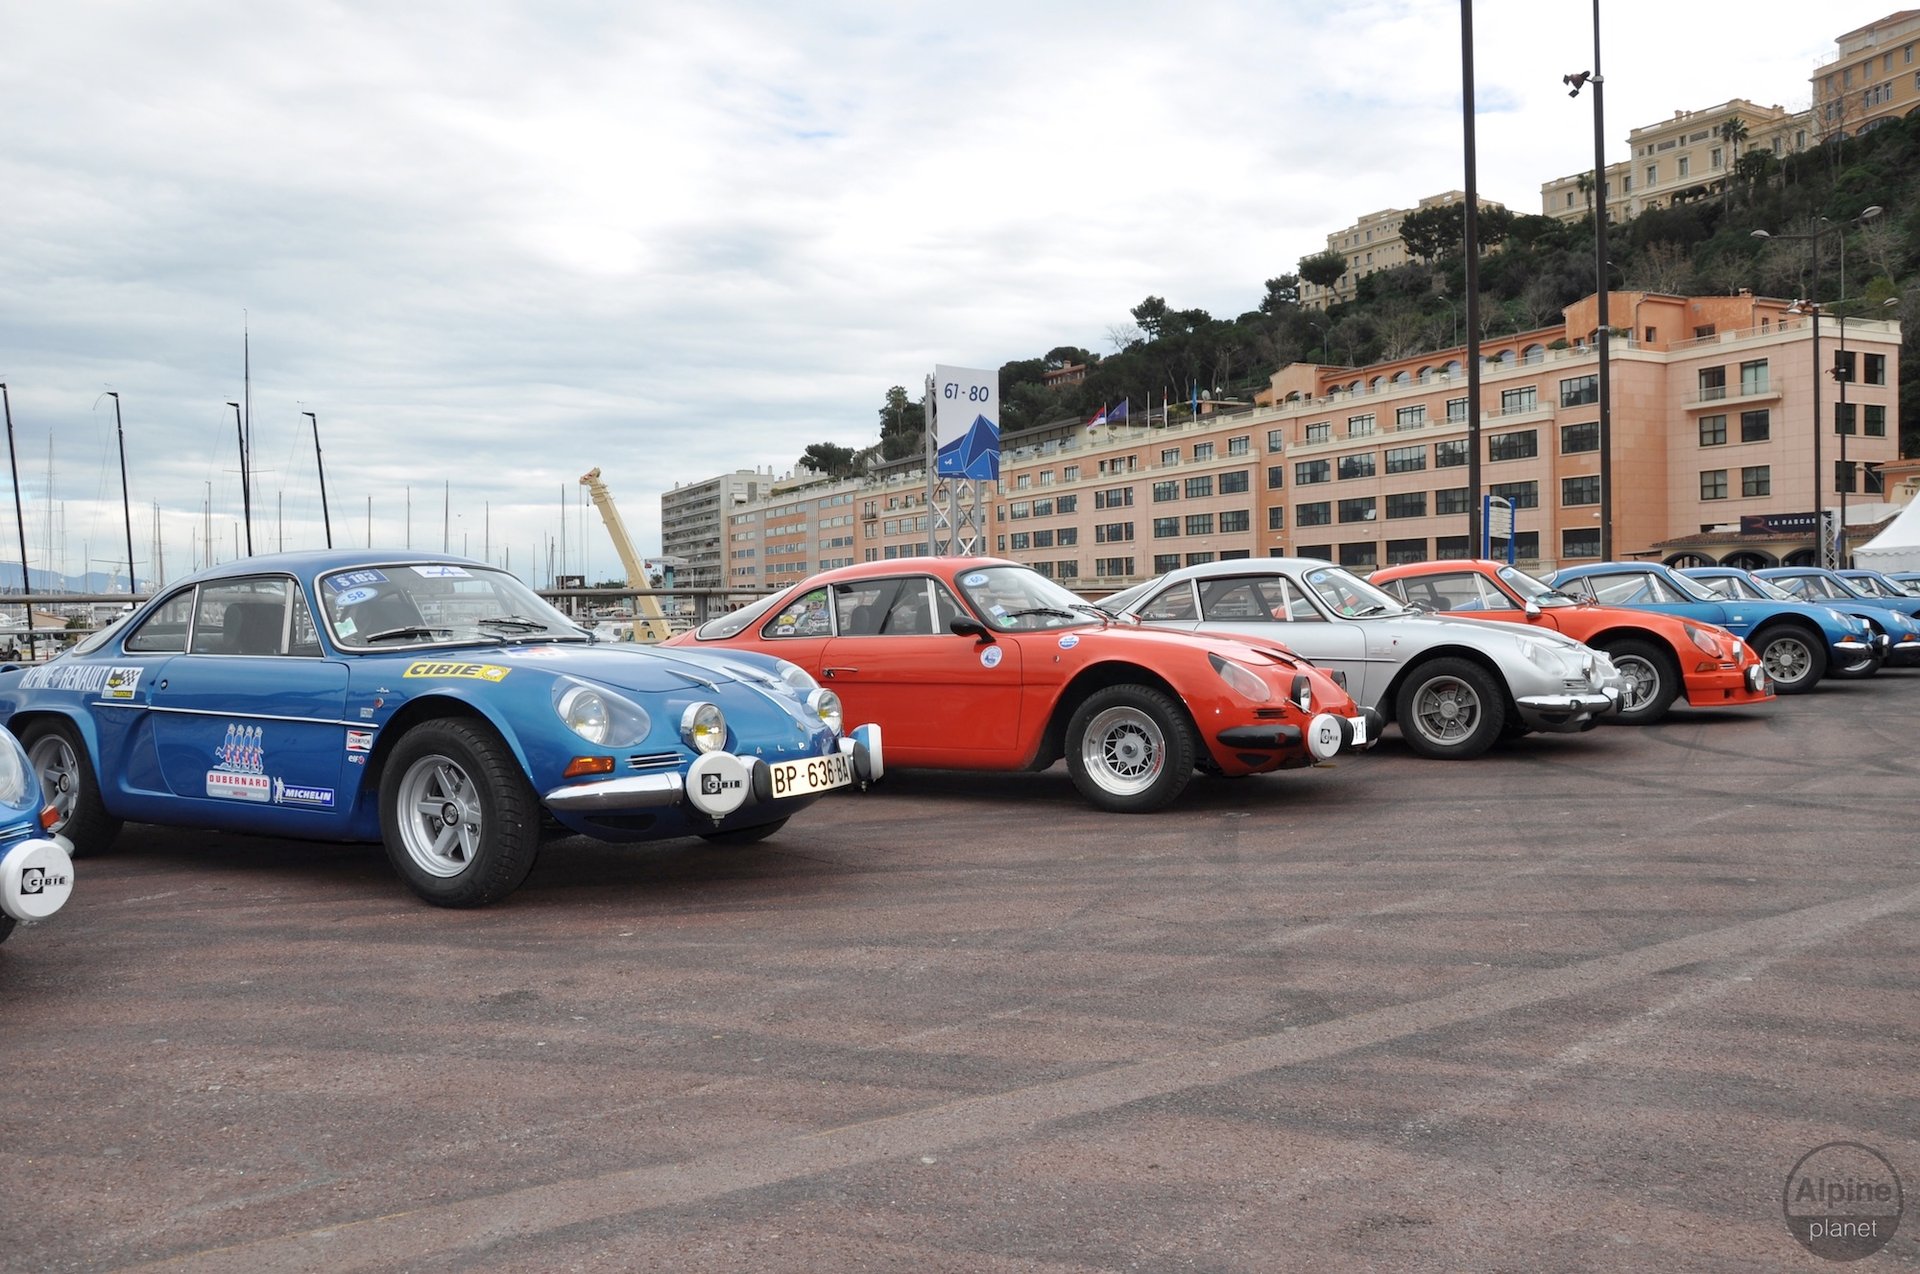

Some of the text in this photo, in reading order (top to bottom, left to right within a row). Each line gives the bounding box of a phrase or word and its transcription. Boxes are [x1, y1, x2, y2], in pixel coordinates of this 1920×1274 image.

[1781, 518, 1816, 526] RASCAS
[336, 577, 351, 587] S
[347, 590, 366, 602] 58
[410, 664, 484, 676] CIBIE
[18, 665, 112, 691] ALPINE RENAULT
[209, 774, 268, 788] DUBERNARD
[285, 788, 332, 801] MICHELIN
[30, 877, 66, 886] CIBIE
